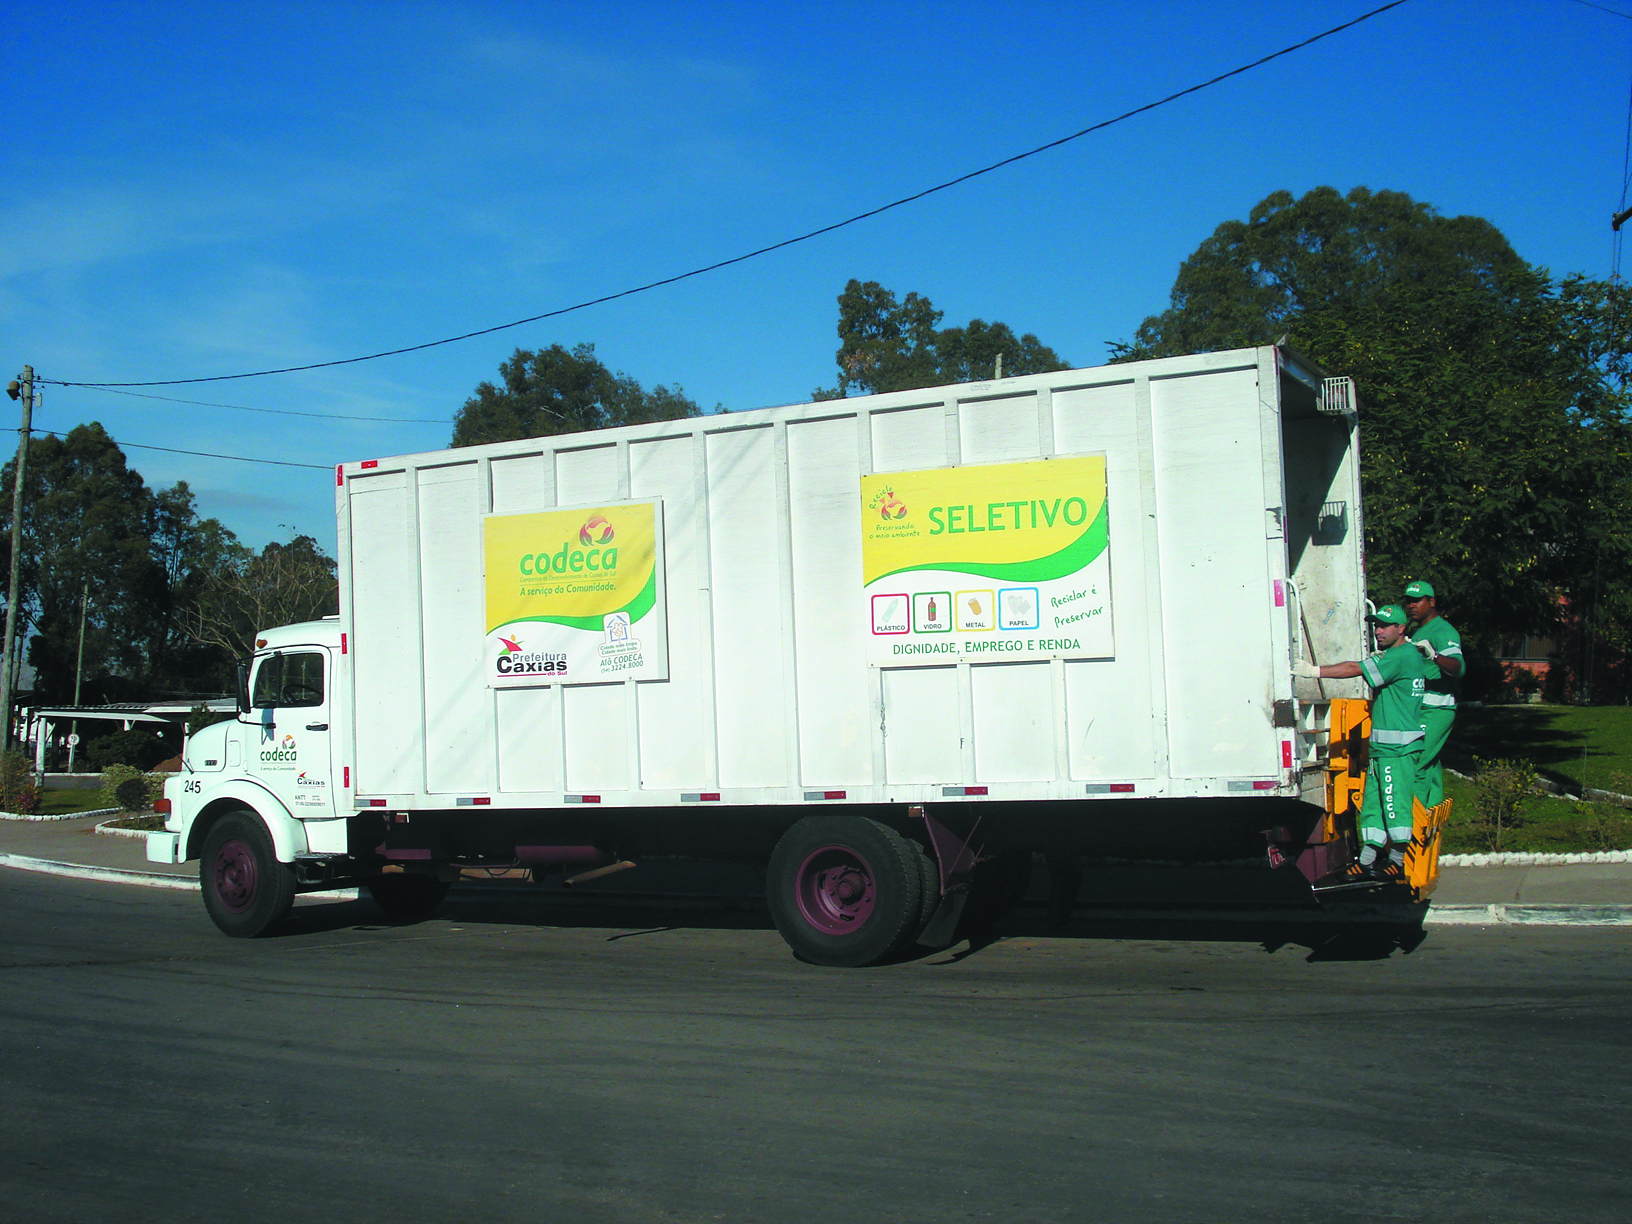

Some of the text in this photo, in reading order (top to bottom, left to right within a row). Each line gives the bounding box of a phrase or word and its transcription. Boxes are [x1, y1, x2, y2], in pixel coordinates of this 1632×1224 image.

[868, 485, 893, 510] Recicle
[928, 497, 1087, 536] SELETIVO
[876, 522, 914, 531] Preservando
[892, 530, 920, 538] ambiente
[519, 542, 618, 576] codeca
[520, 581, 617, 597] A serviço da Comunidade.
[1050, 584, 1098, 609] Reciclar é
[1054, 606, 1103, 629] Preservar
[876, 624, 906, 632] PLÁSTICO
[893, 638, 1081, 656] DIGNIDADE, EMPREGO E RENDA
[496, 656, 568, 674] Caxias
[512, 652, 568, 664] Prefeitura
[613, 653, 643, 664] CODECA
[260, 747, 297, 762] codeca
[184, 780, 201, 794] 245
[297, 777, 326, 786] Caxias
[1384, 766, 1396, 819] codeca
